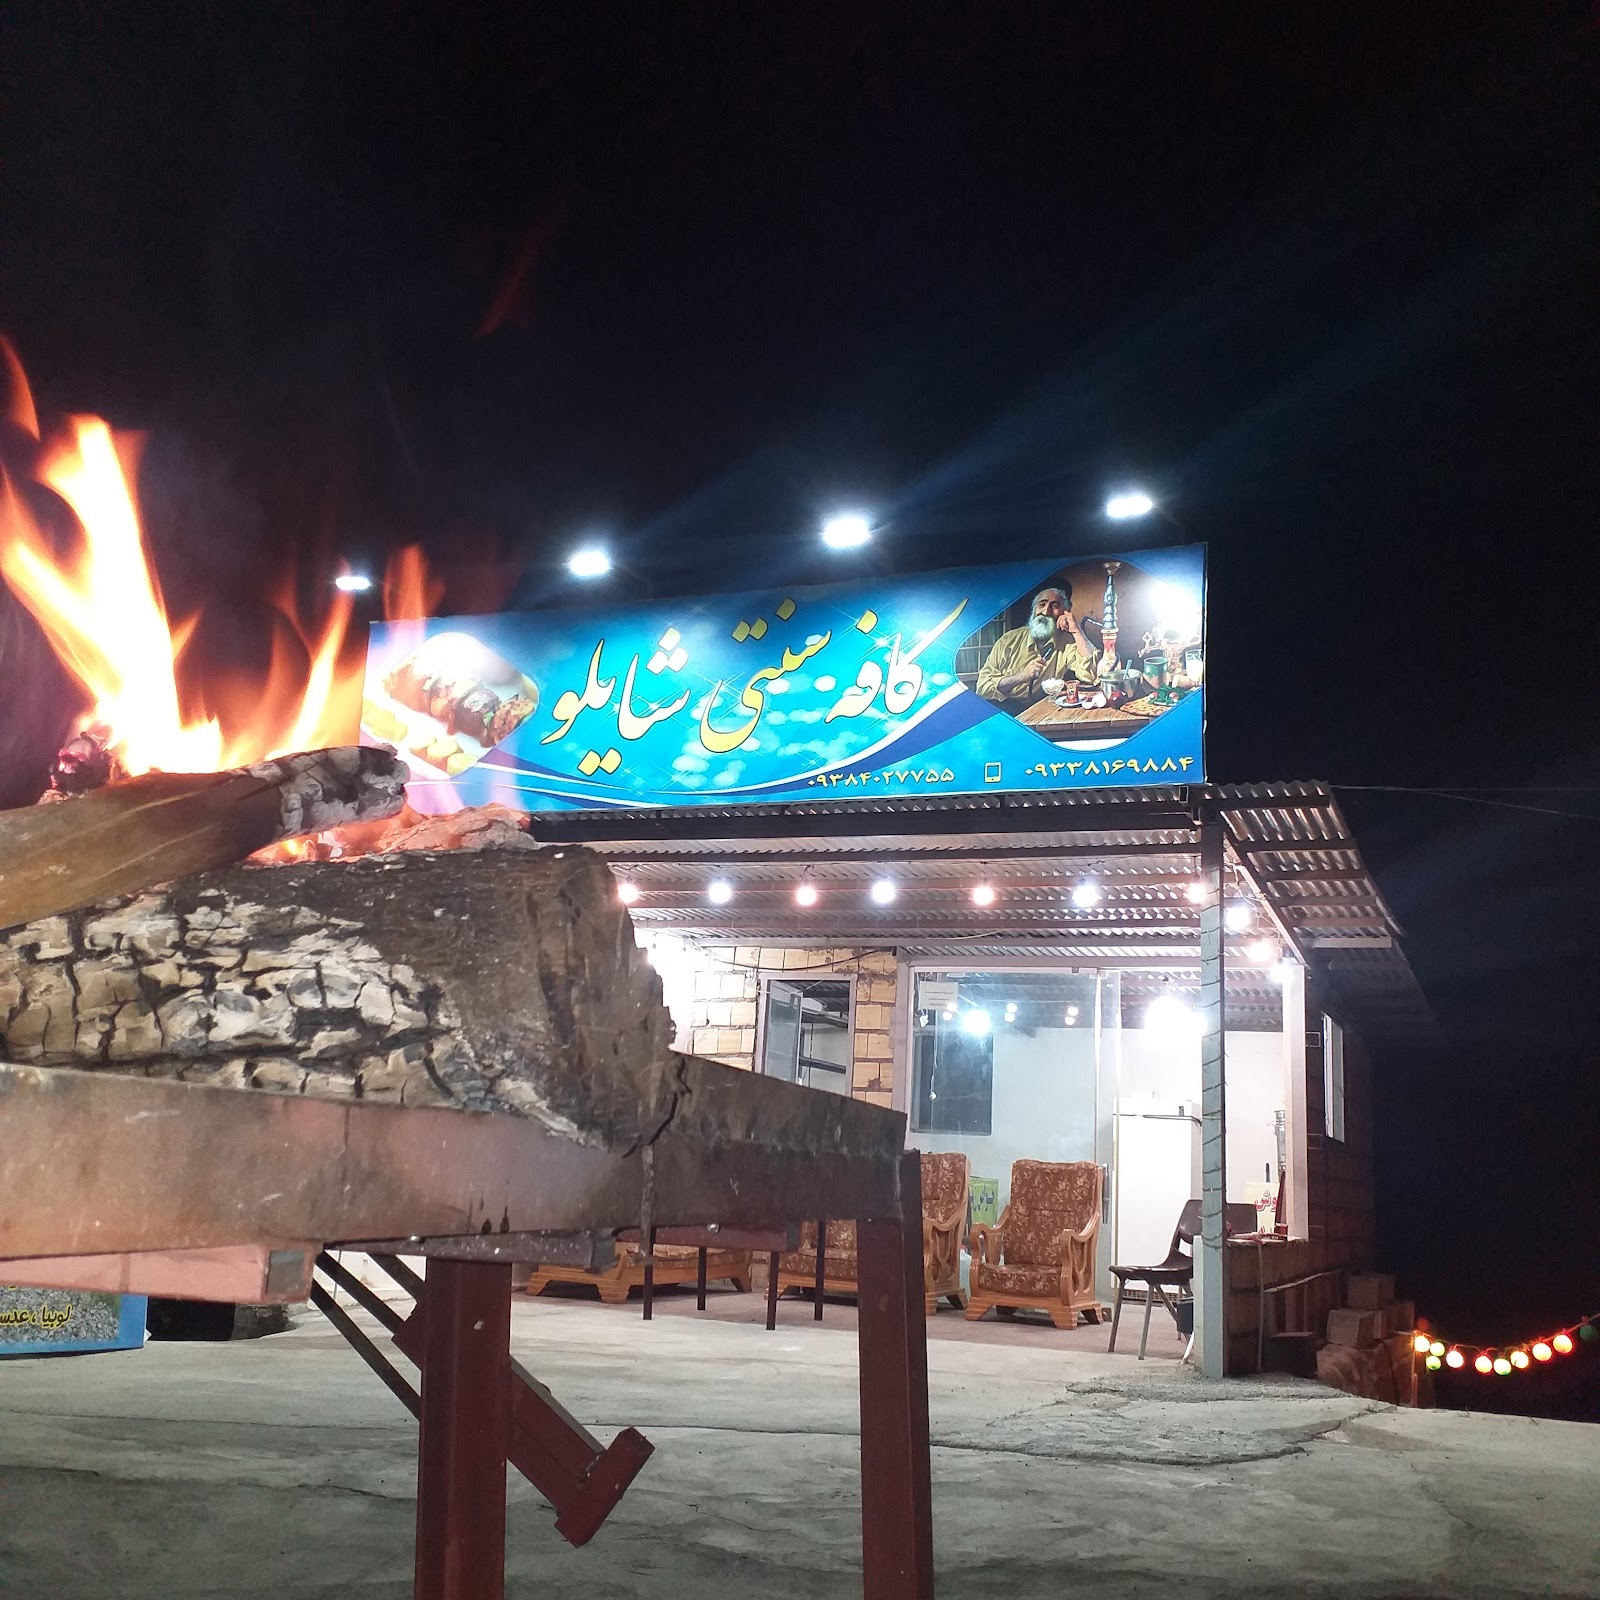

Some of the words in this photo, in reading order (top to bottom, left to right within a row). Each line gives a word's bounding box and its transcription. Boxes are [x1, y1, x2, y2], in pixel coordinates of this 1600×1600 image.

[539, 626, 691, 776] شایلو
[699, 598, 832, 754] سنتی
[824, 597, 969, 724] کافه
[807, 767, 955, 788] ۰۹۳۸۴۰۲۷۷۵۵
[1024, 756, 1194, 778] ۰۹۳۳۸۱۶۹۸۸۴
